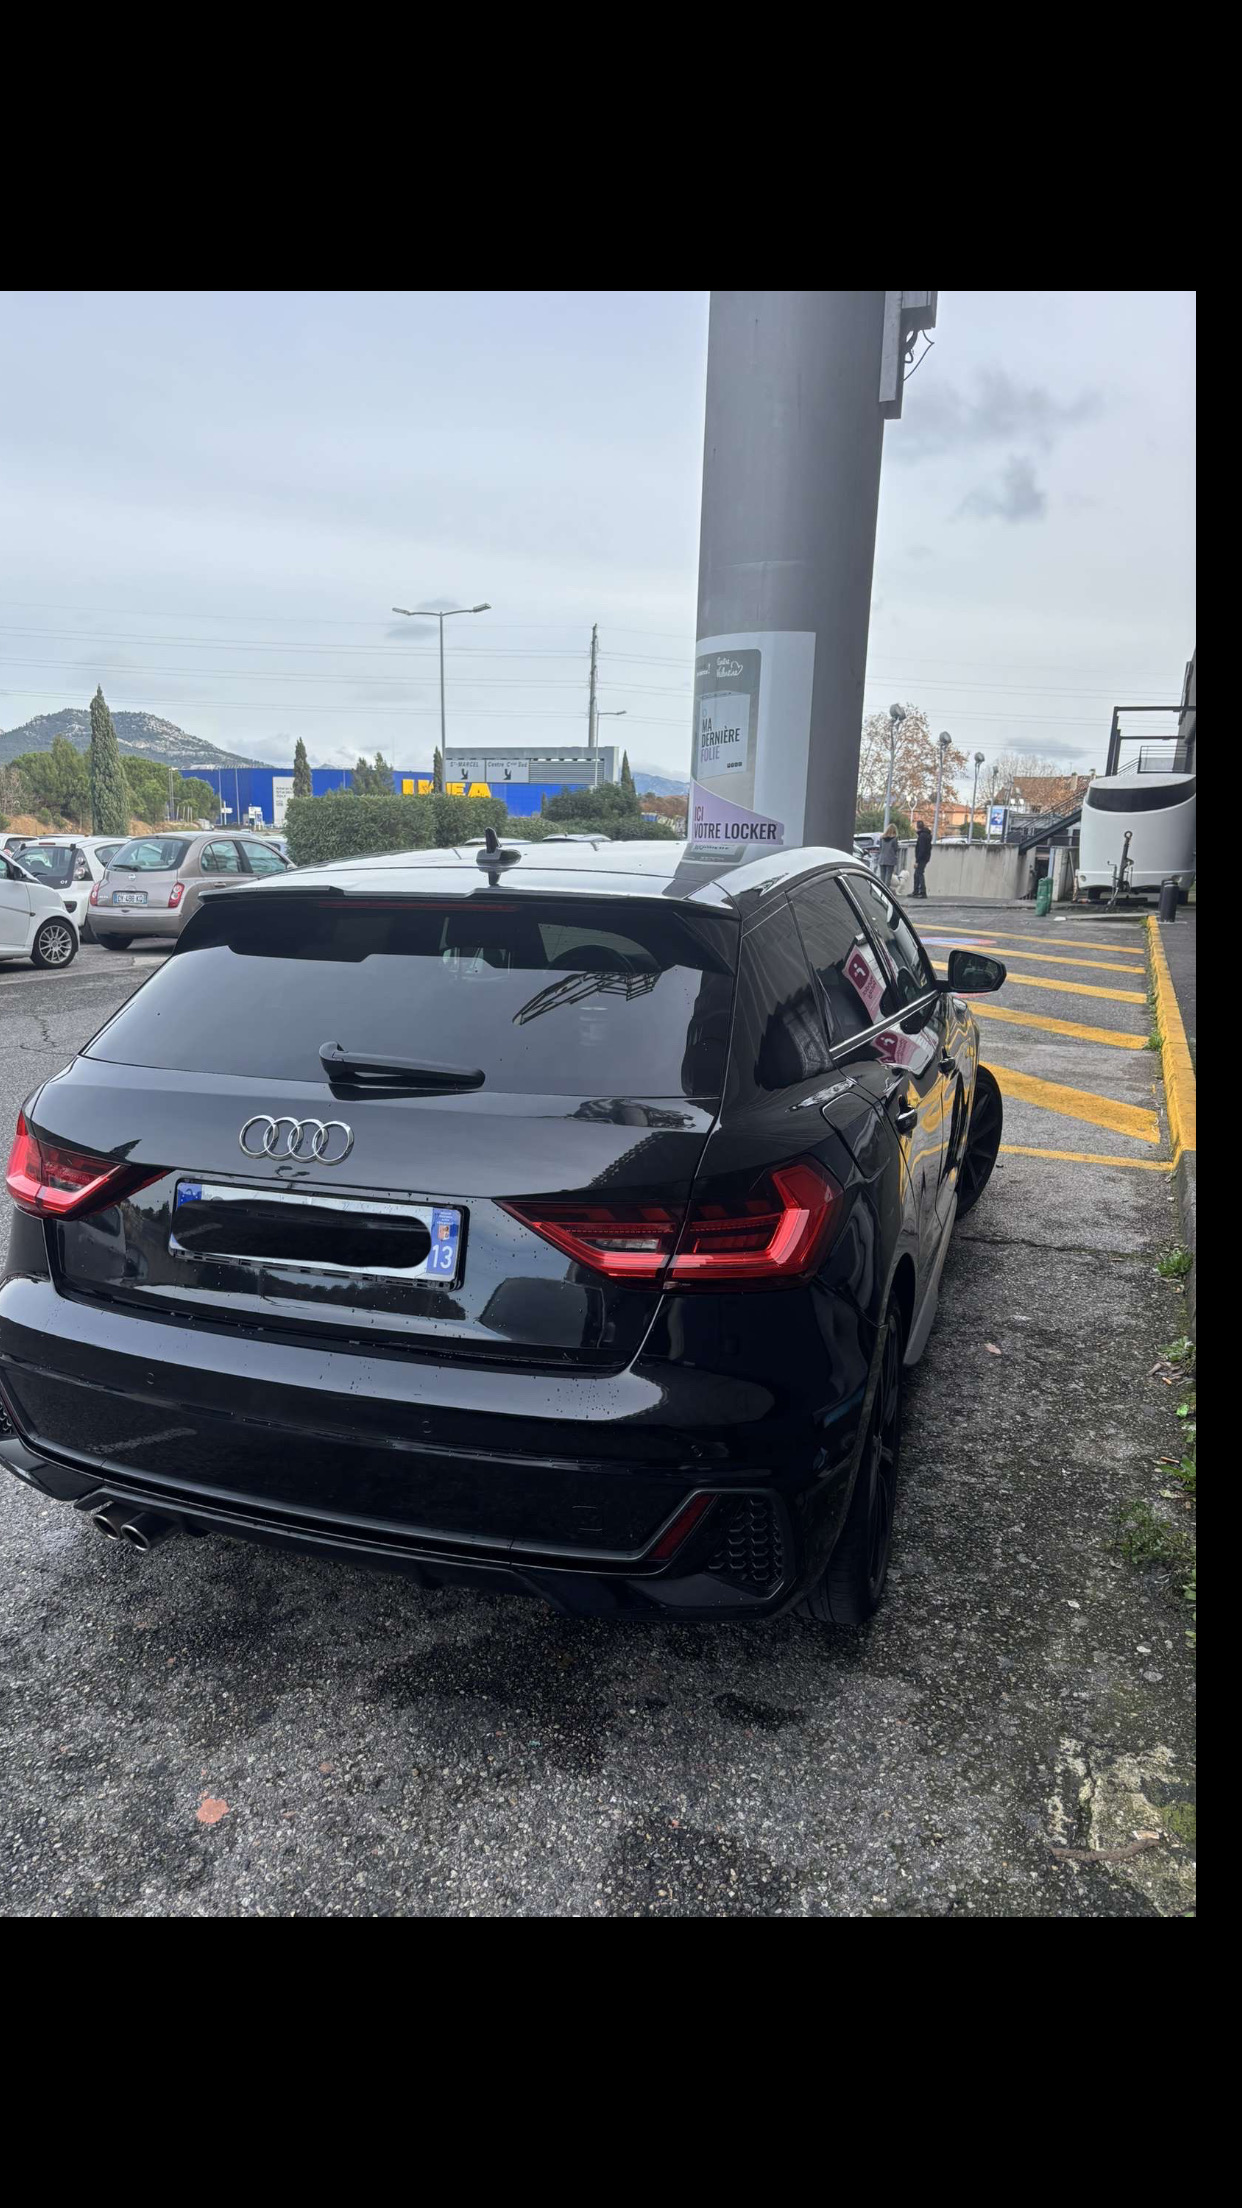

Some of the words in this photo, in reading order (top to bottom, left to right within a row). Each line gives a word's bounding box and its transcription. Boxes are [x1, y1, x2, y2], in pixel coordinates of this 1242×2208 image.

[702, 718, 712, 733] MA
[702, 725, 741, 748] DERNIÈRE
[701, 746, 720, 763] FOLIE
[695, 806, 704, 821] ICI
[694, 823, 721, 839] VOTRE
[725, 823, 777, 840] LOCKER
[432, 1244, 454, 1269] 13
